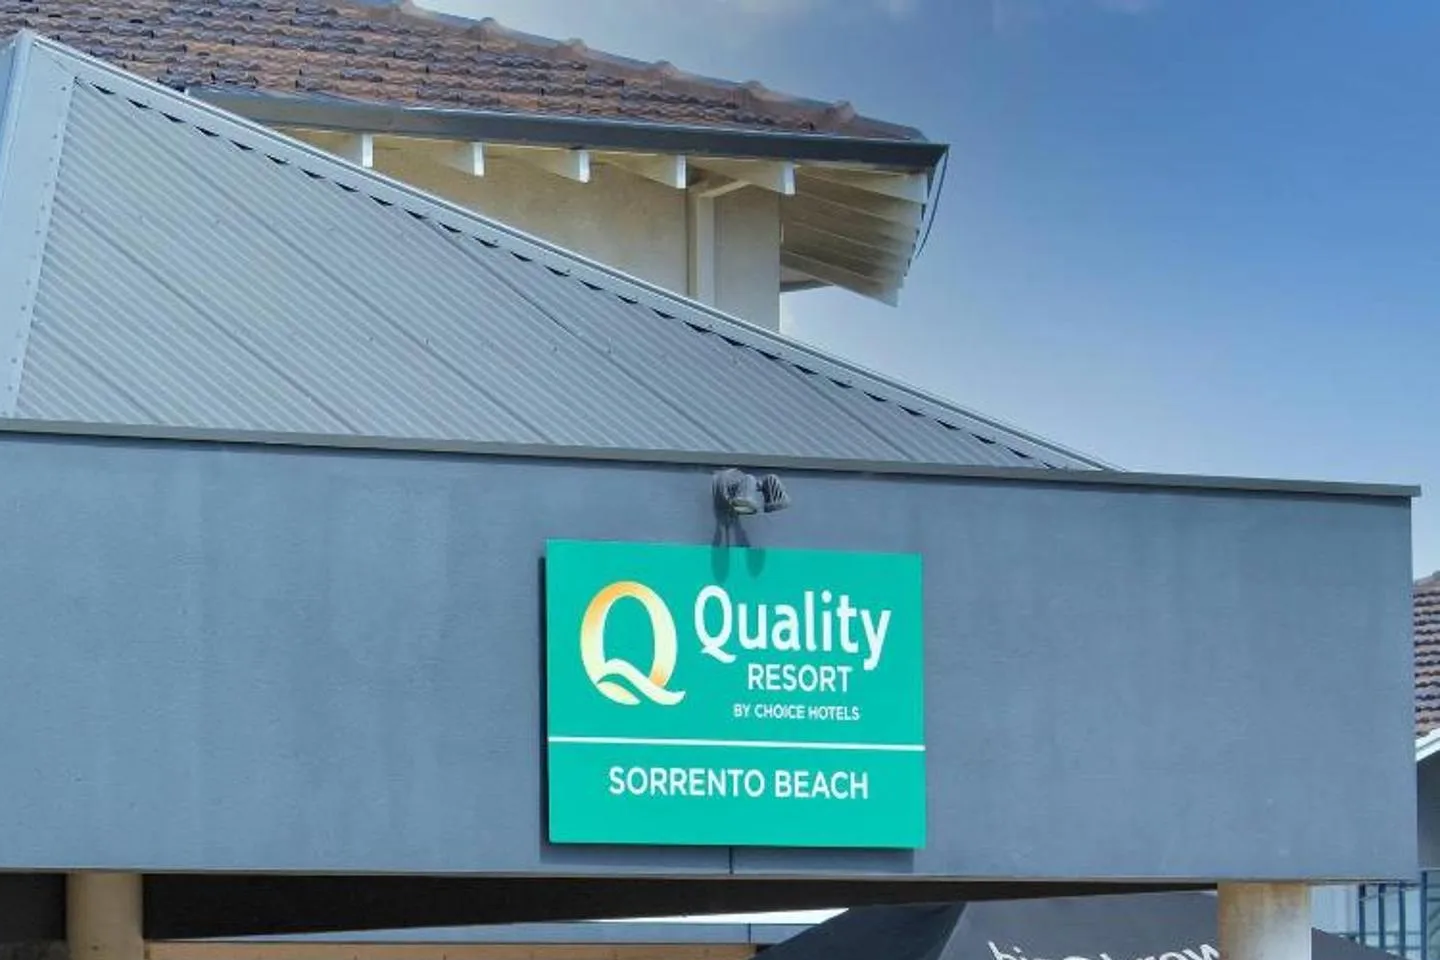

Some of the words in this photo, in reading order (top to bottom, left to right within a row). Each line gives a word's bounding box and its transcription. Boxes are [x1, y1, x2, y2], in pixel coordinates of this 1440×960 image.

[694, 584, 892, 671] Quality
[747, 663, 853, 693] RESORT
[733, 703, 750, 718] BY
[754, 704, 806, 720] CHOICE
[808, 705, 861, 722] HOTELS
[608, 766, 766, 798] SORRENTO
[774, 770, 870, 800] BEACH
